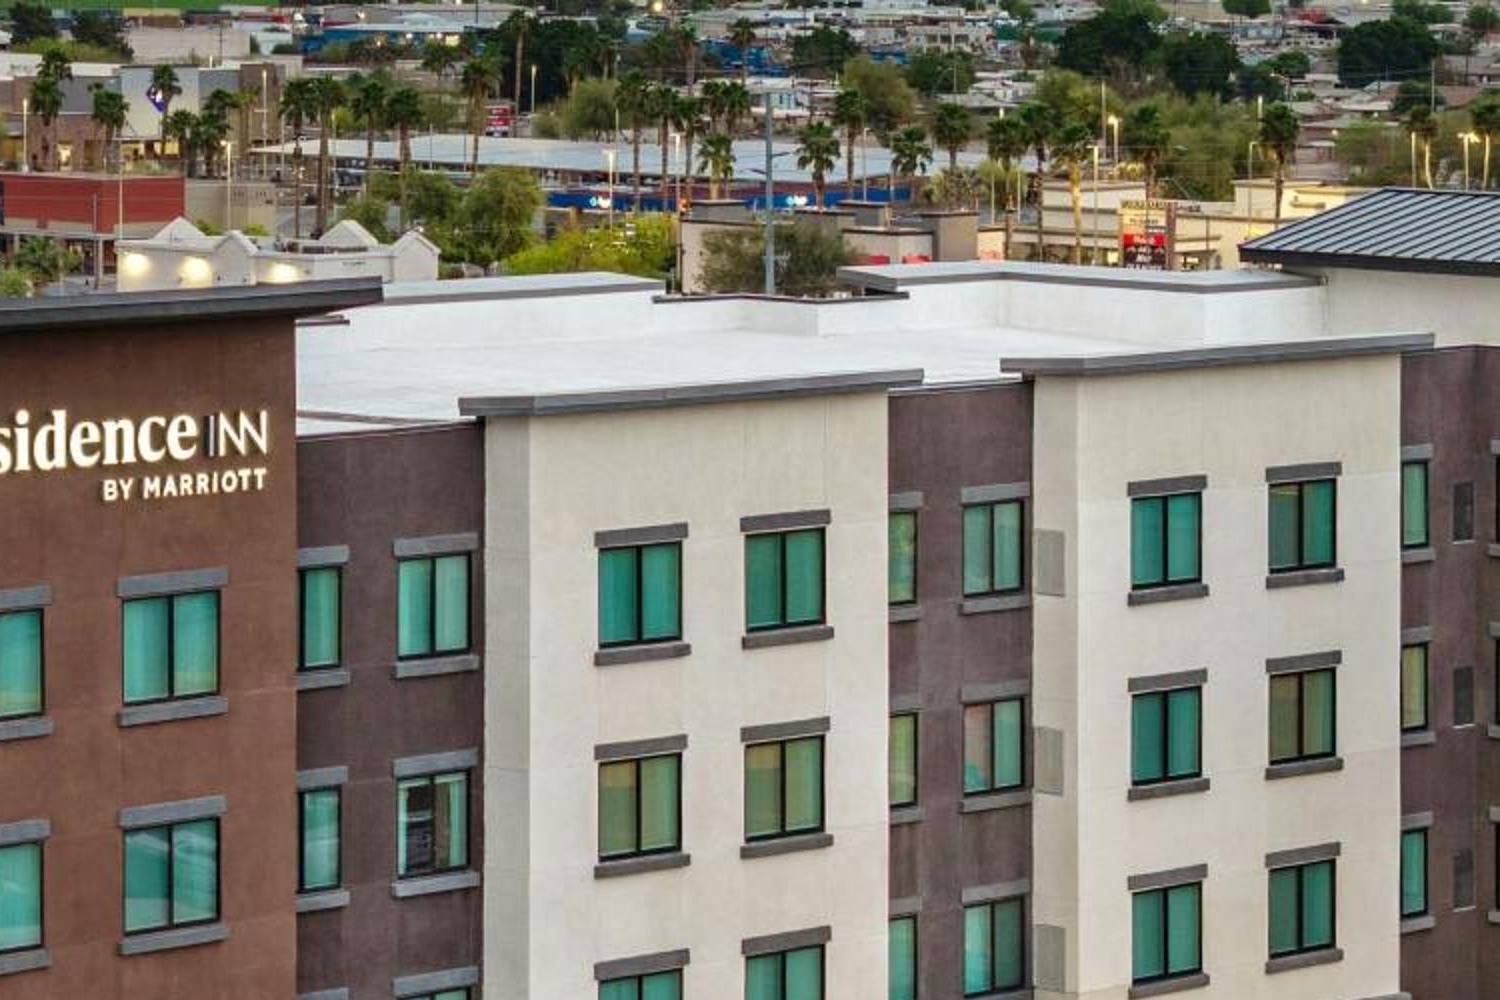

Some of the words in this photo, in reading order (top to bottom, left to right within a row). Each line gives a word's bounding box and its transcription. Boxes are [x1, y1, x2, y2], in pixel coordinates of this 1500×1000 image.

[208, 410, 269, 457] INN
[103, 478, 134, 501] BY
[143, 467, 268, 499] MARRIOTT
